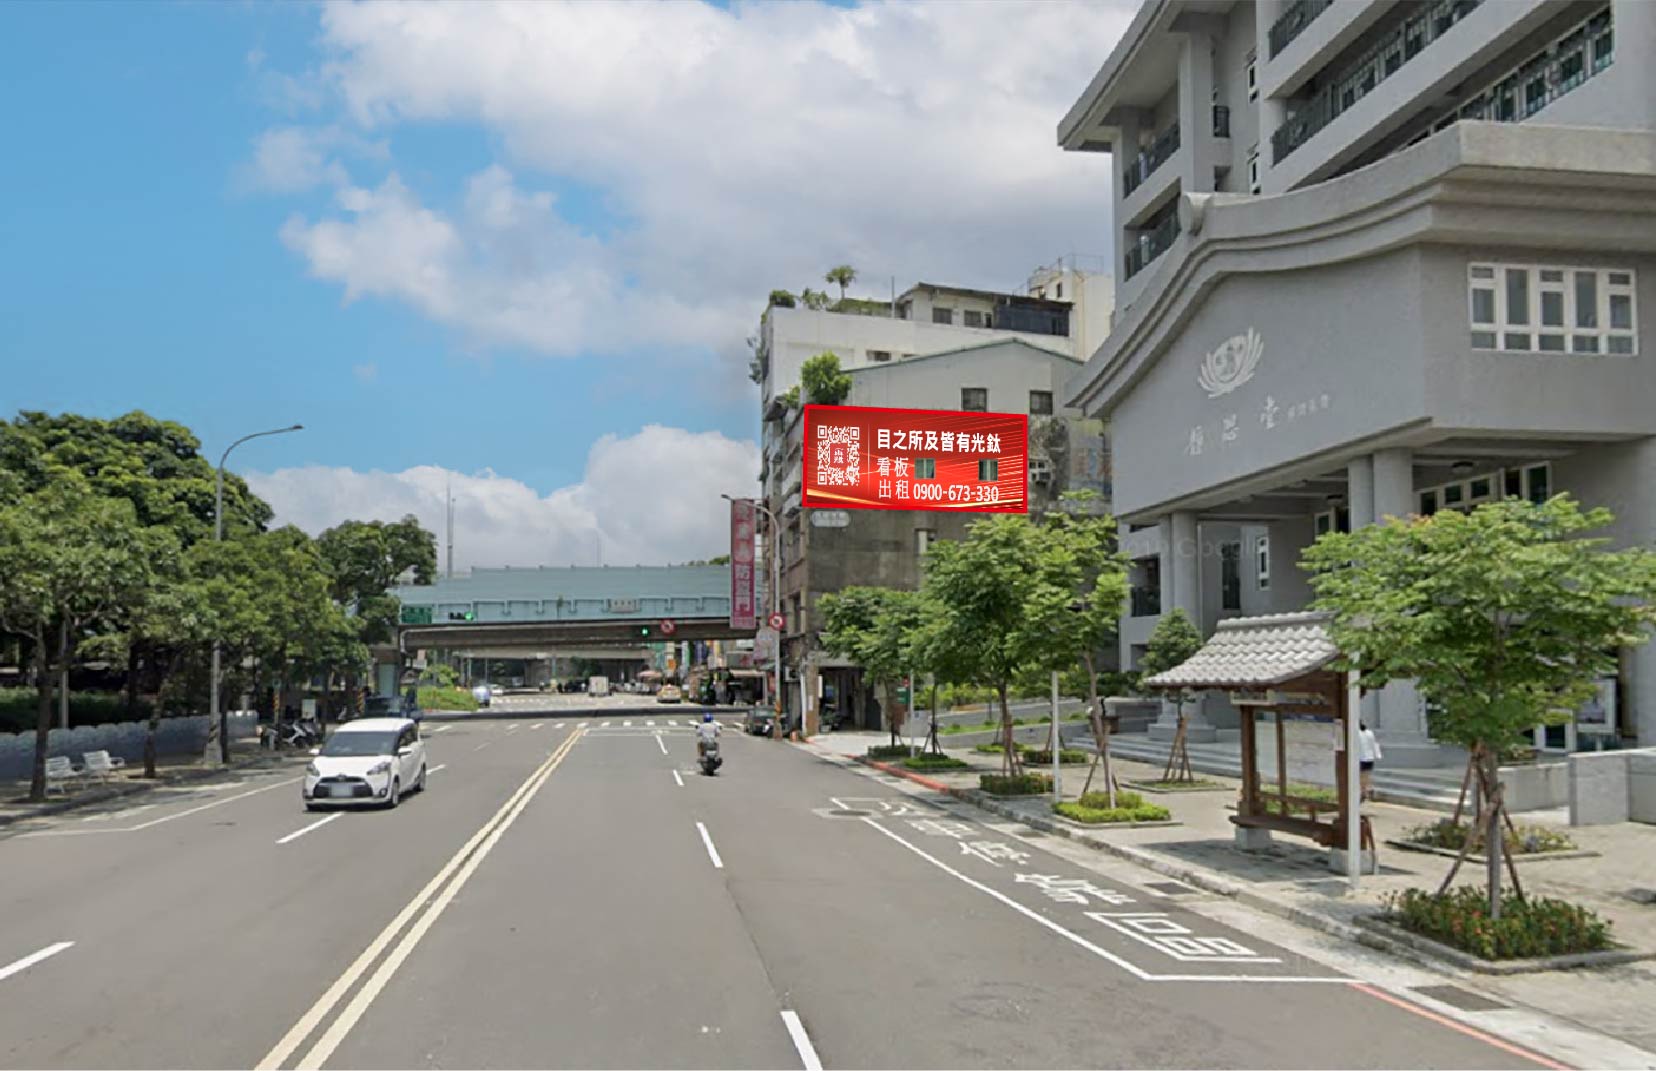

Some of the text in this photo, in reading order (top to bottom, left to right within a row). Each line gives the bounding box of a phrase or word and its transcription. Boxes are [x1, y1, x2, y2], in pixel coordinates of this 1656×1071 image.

[877, 429, 1001, 454] 目之所及皆有光鈦
[877, 456, 909, 477] 看板
[878, 479, 999, 502] 出租 0900-673-330
